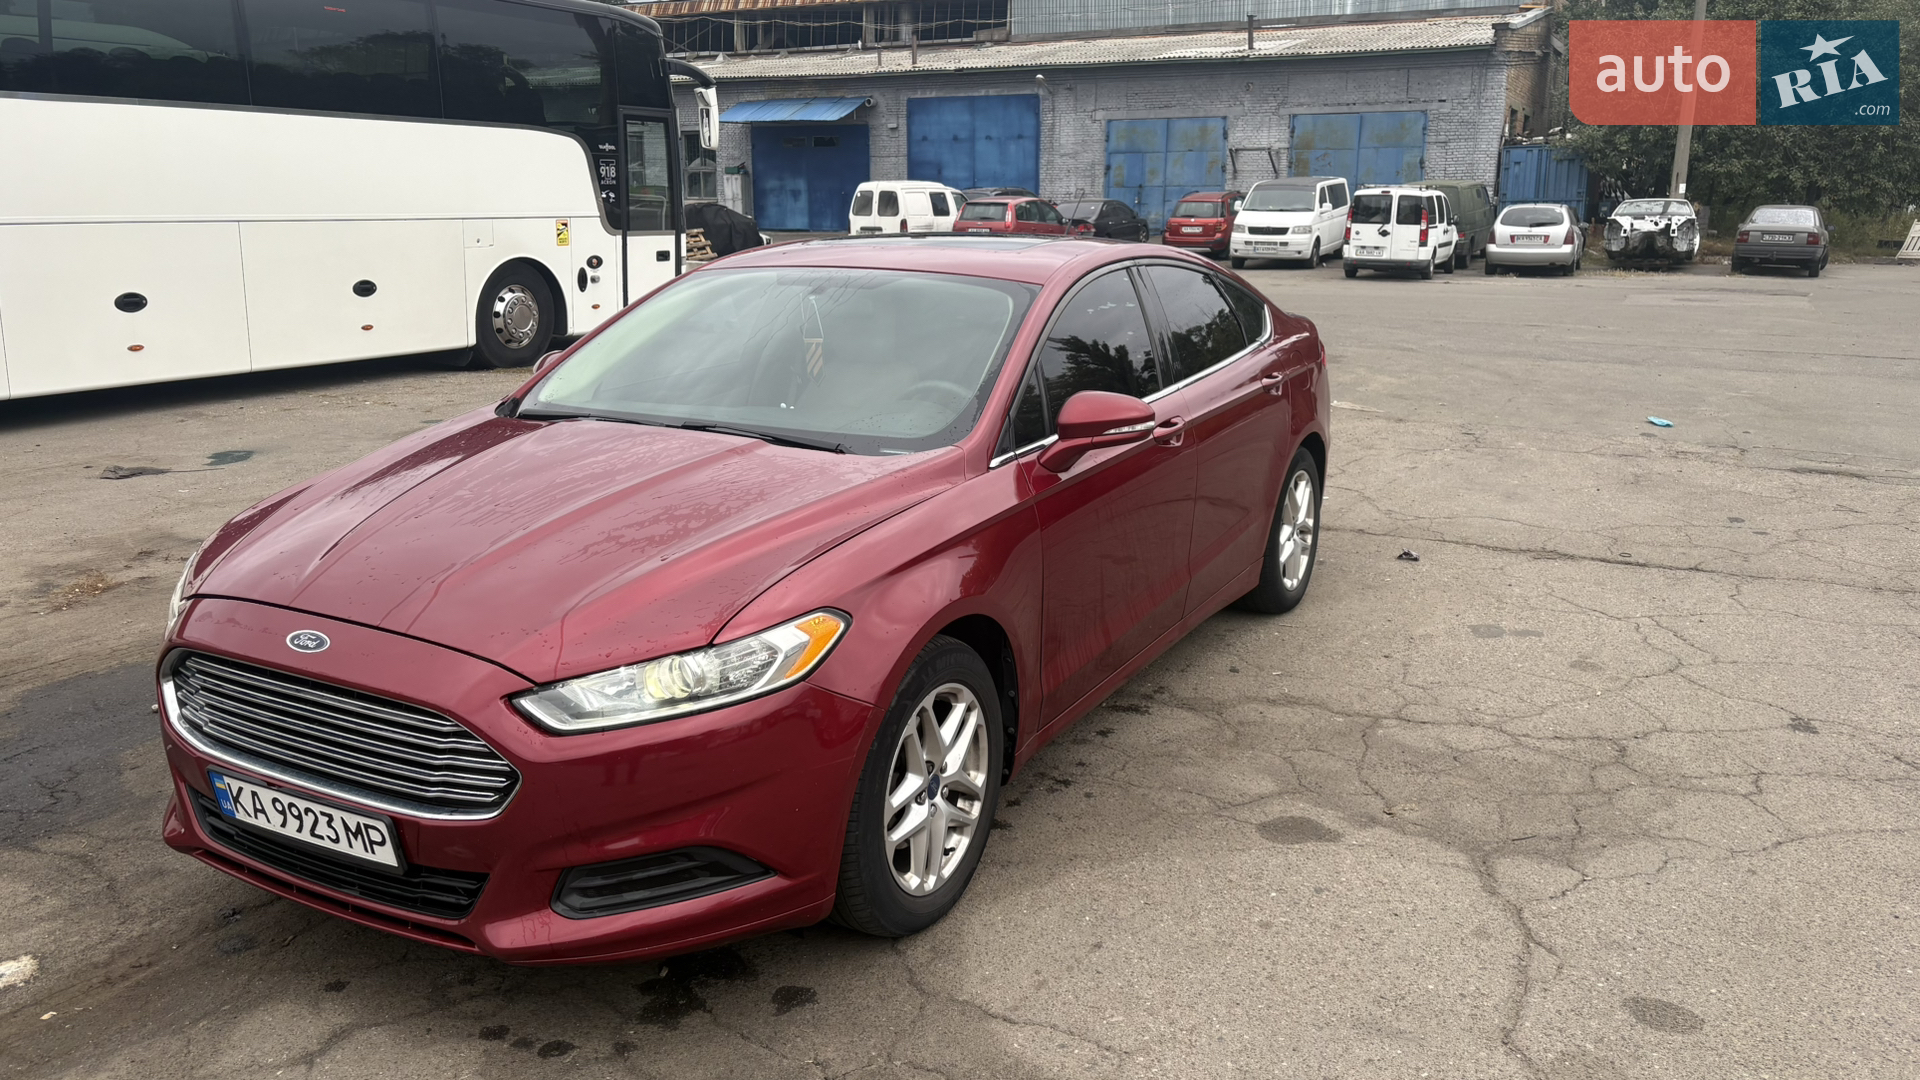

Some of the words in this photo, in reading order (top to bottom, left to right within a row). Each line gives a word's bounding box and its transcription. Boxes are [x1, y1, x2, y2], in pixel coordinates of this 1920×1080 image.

[600, 166, 616, 178] 918
[294, 633, 320, 648] Ford
[221, 799, 233, 811] UA
[227, 782, 272, 825] KA
[271, 796, 341, 844] 9923
[340, 815, 387, 856] MP
